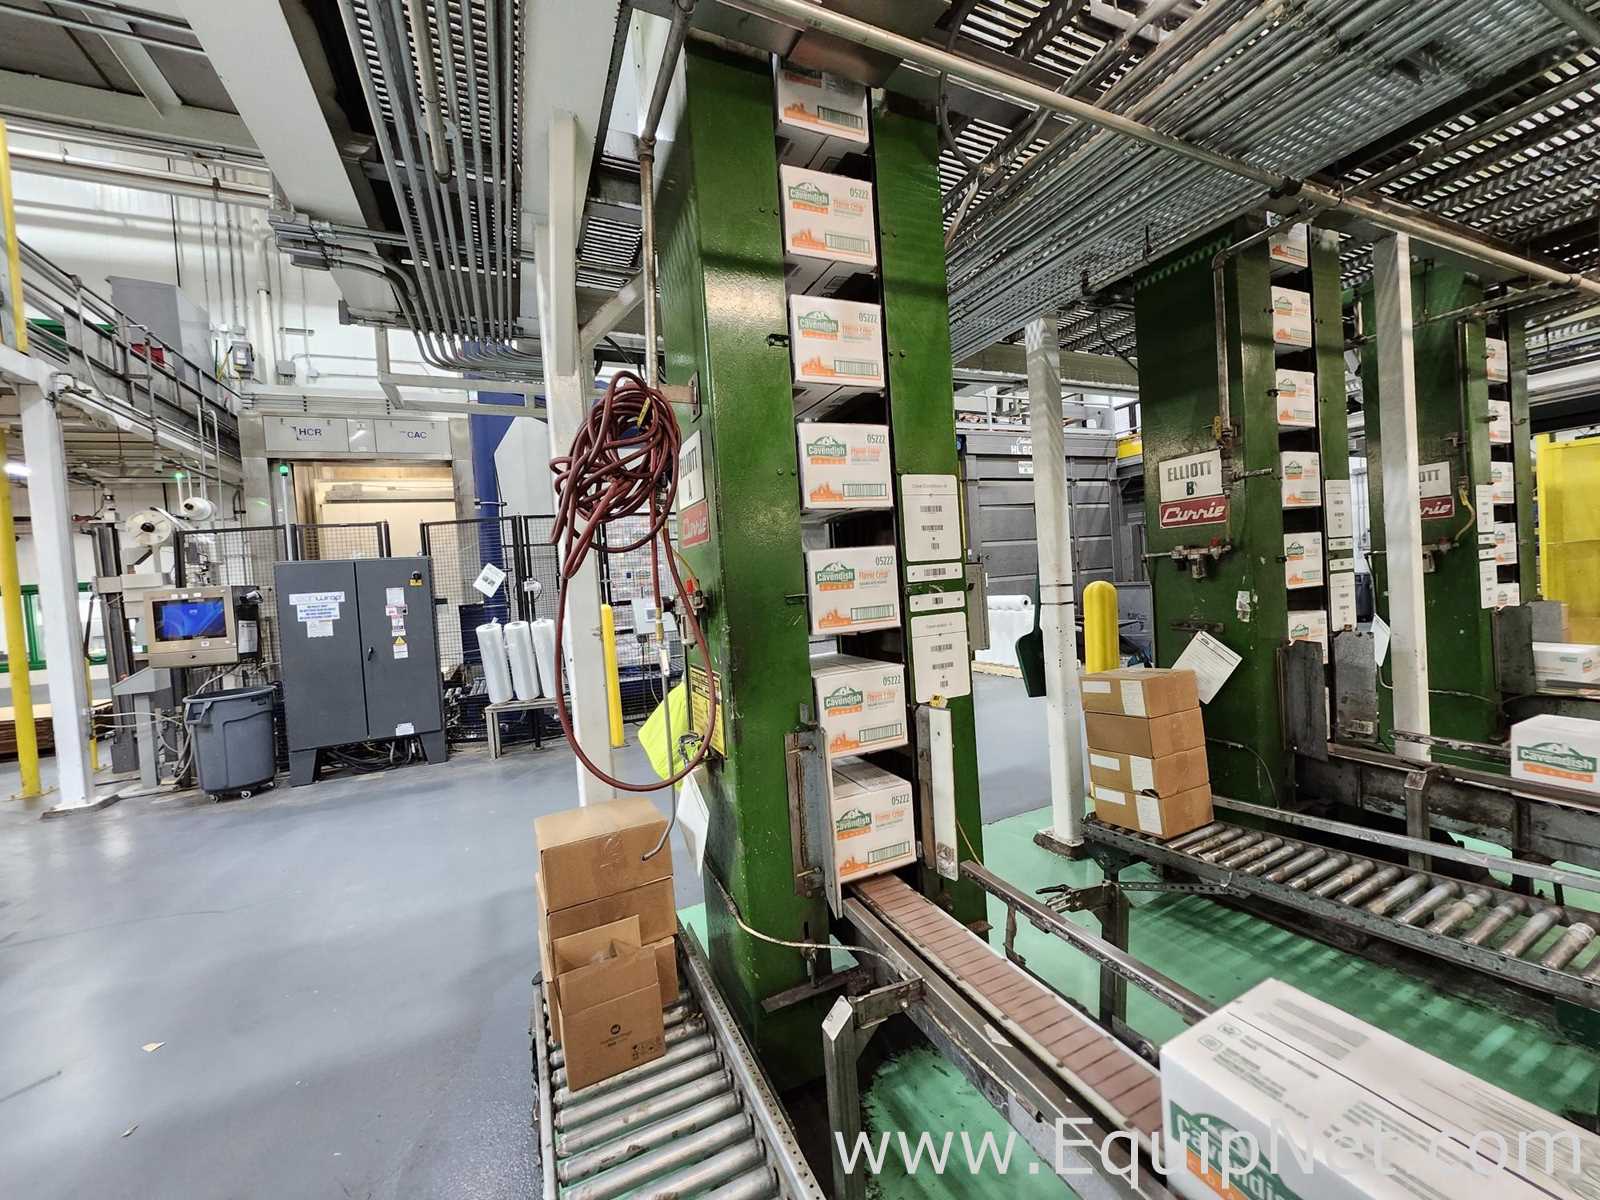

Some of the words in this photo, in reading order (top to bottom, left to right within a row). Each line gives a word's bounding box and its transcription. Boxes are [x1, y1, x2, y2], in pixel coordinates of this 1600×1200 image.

[298, 428, 322, 437] HCR
[407, 430, 427, 440] CAC
[808, 445, 845, 456] Cavendish
[1167, 460, 1212, 481] ELLIOTT
[1186, 481, 1195, 495] B
[1162, 501, 1225, 523] Currie
[816, 569, 854, 583] Cavendish
[825, 693, 862, 707] Cavendish
